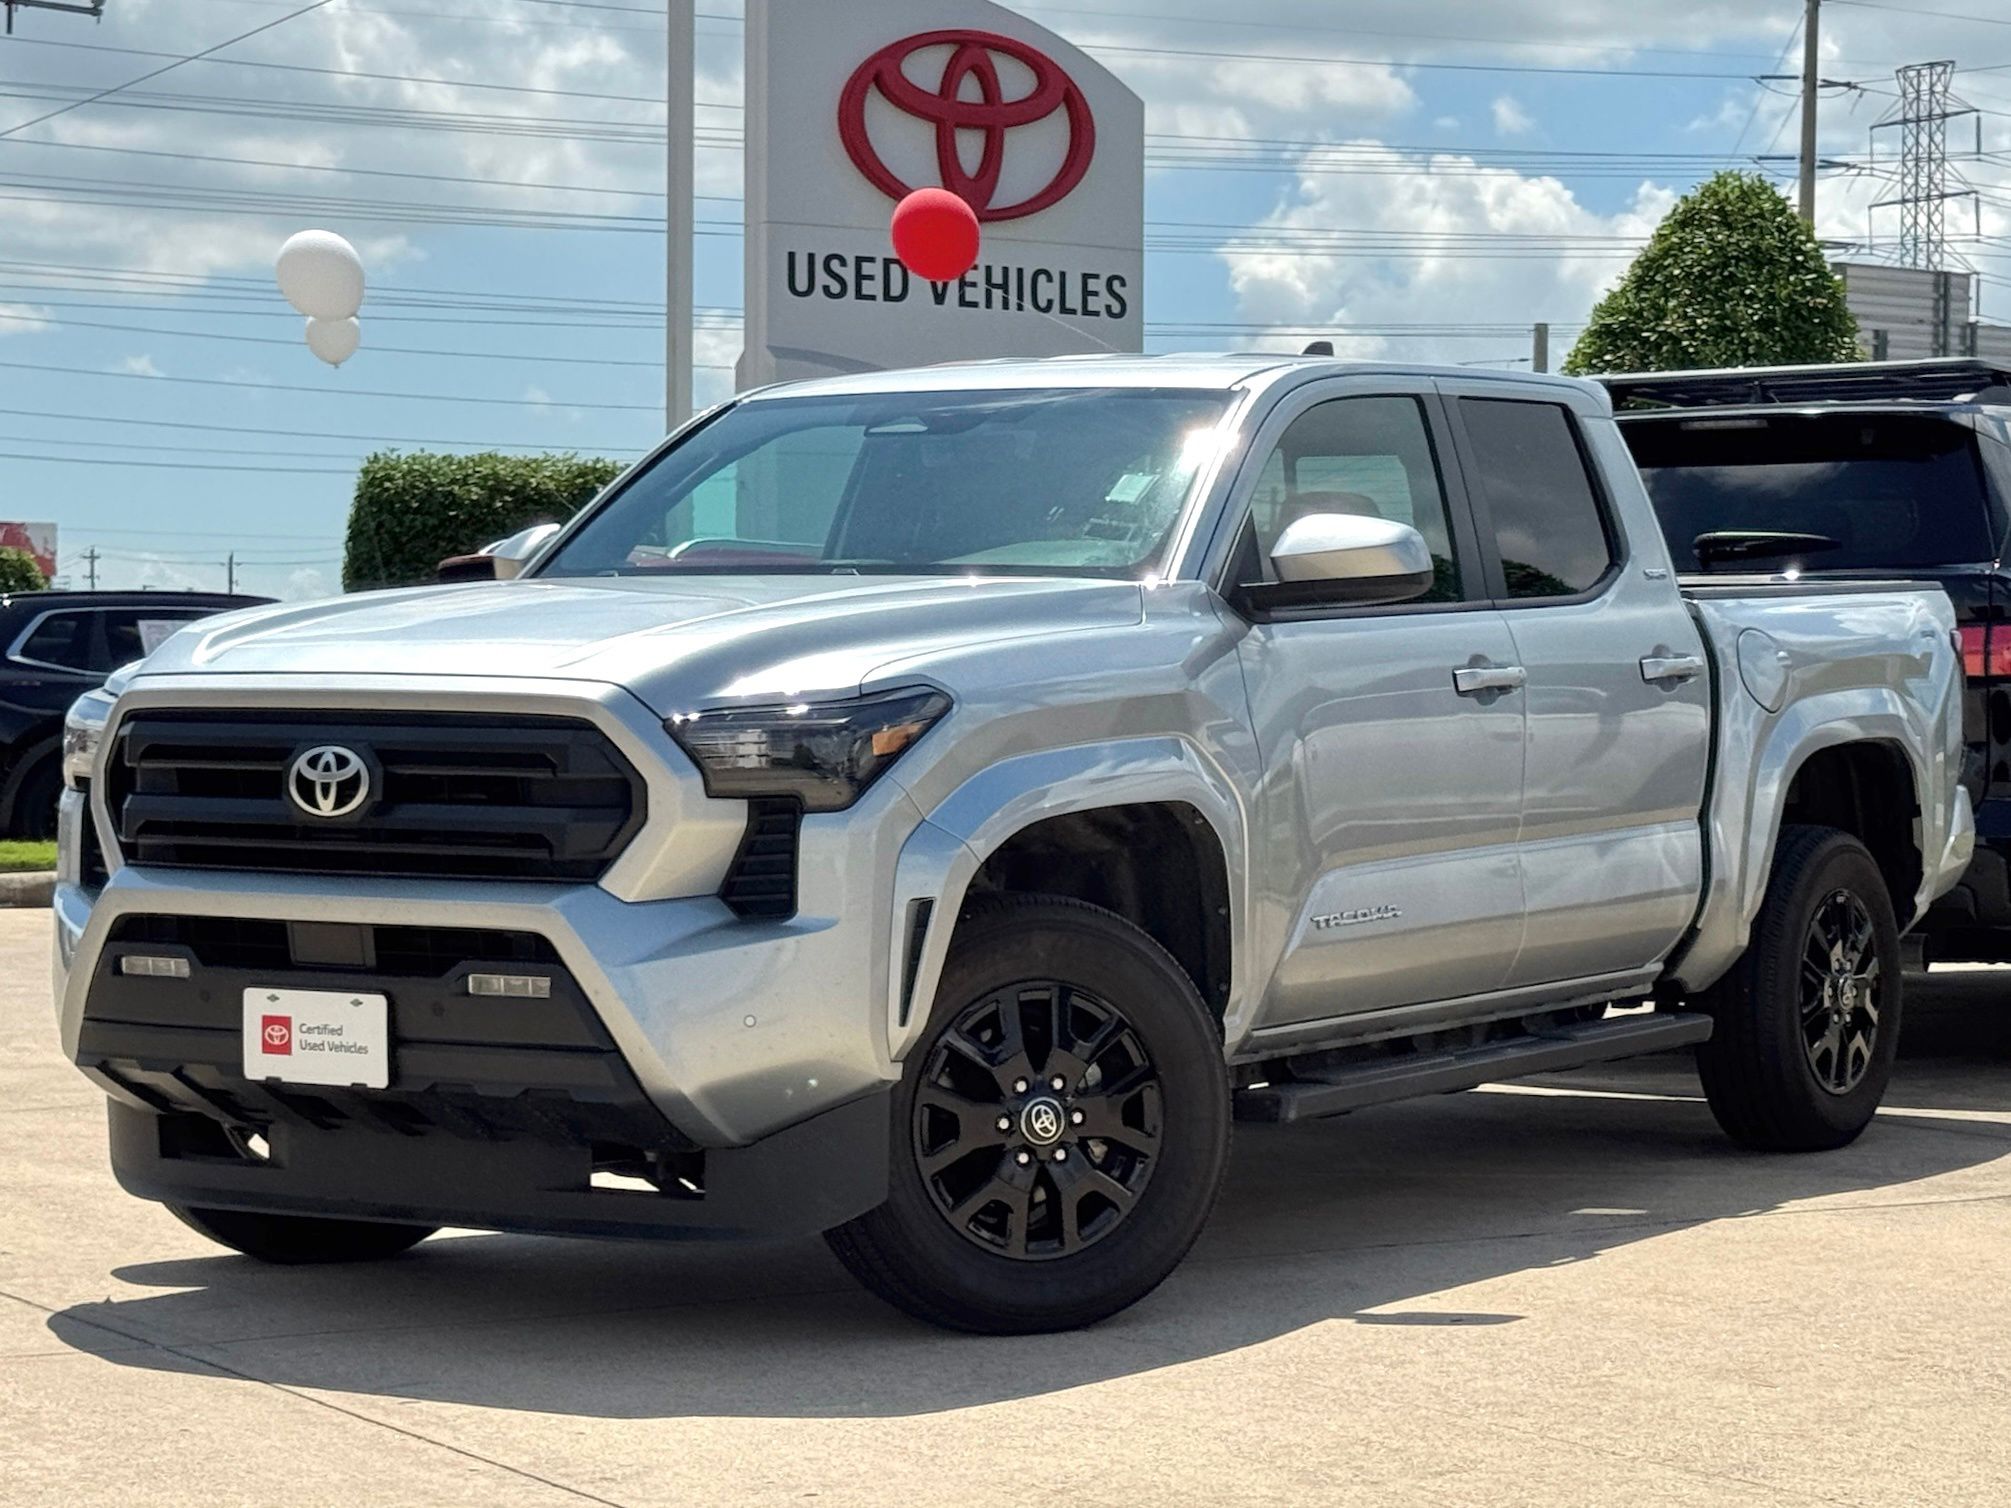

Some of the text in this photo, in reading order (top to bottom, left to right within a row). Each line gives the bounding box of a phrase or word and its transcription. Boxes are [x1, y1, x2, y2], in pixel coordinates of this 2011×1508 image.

[787, 251, 910, 303] USED
[300, 1023, 343, 1036] Certified
[299, 1039, 369, 1054] Used Vehicles
